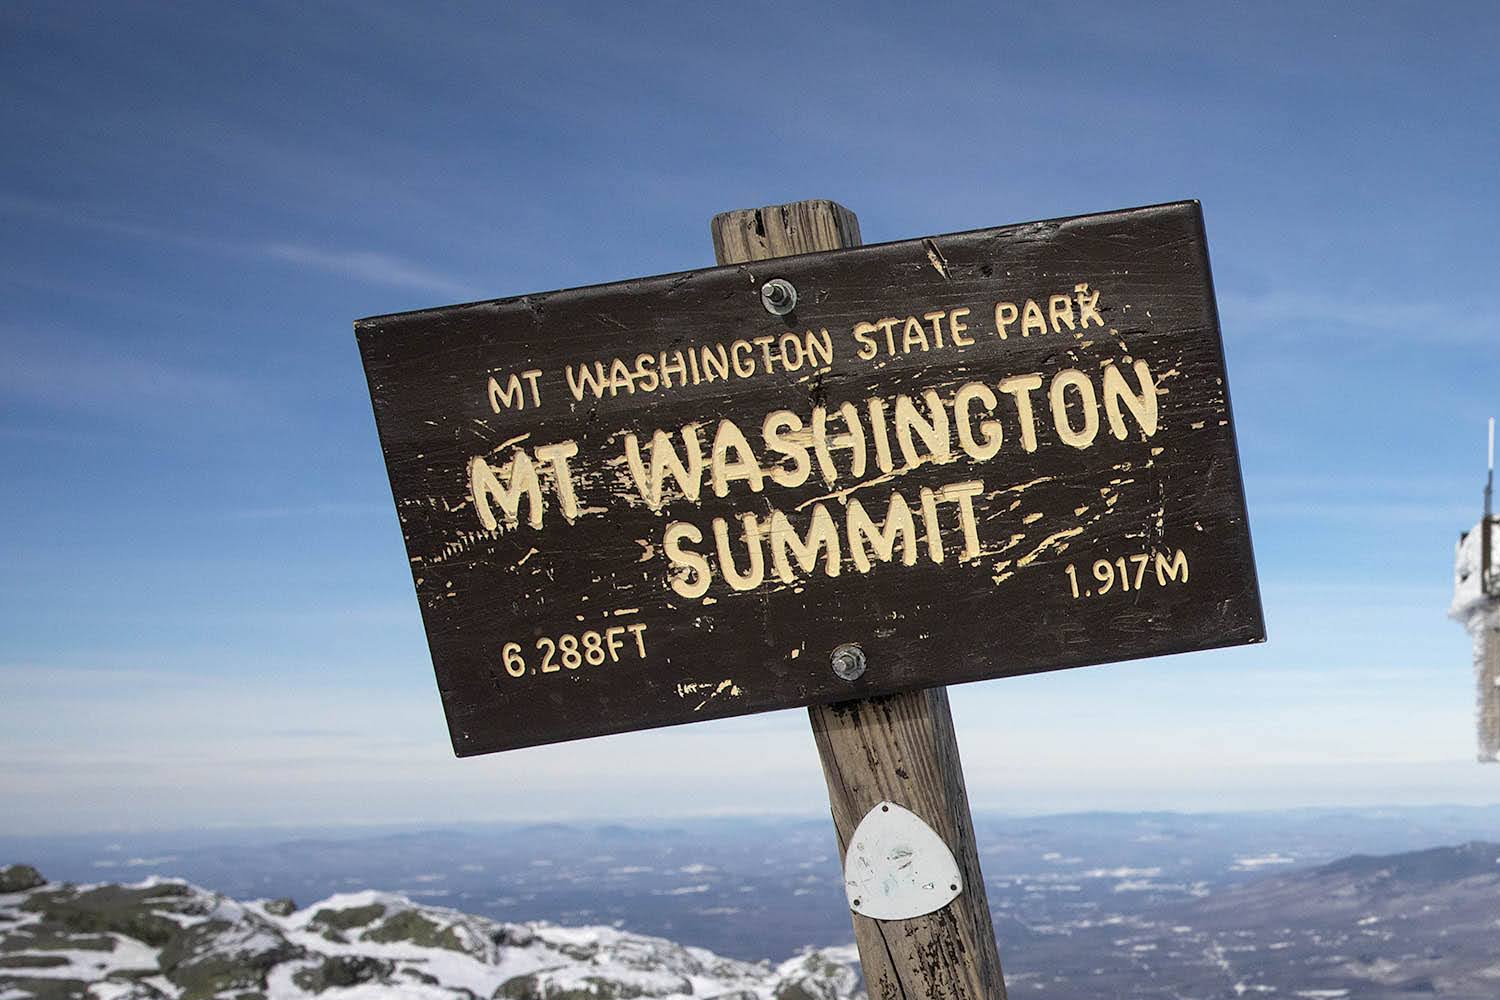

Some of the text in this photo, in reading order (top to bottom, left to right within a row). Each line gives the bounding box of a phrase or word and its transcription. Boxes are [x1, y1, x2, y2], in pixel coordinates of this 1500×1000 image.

[487, 283, 1105, 415] MT WASHINGTON STATE PARK
[469, 360, 1160, 532] MT WASHINGTON
[665, 480, 986, 600] SUMMIT
[1064, 548, 1189, 599] 1.917M
